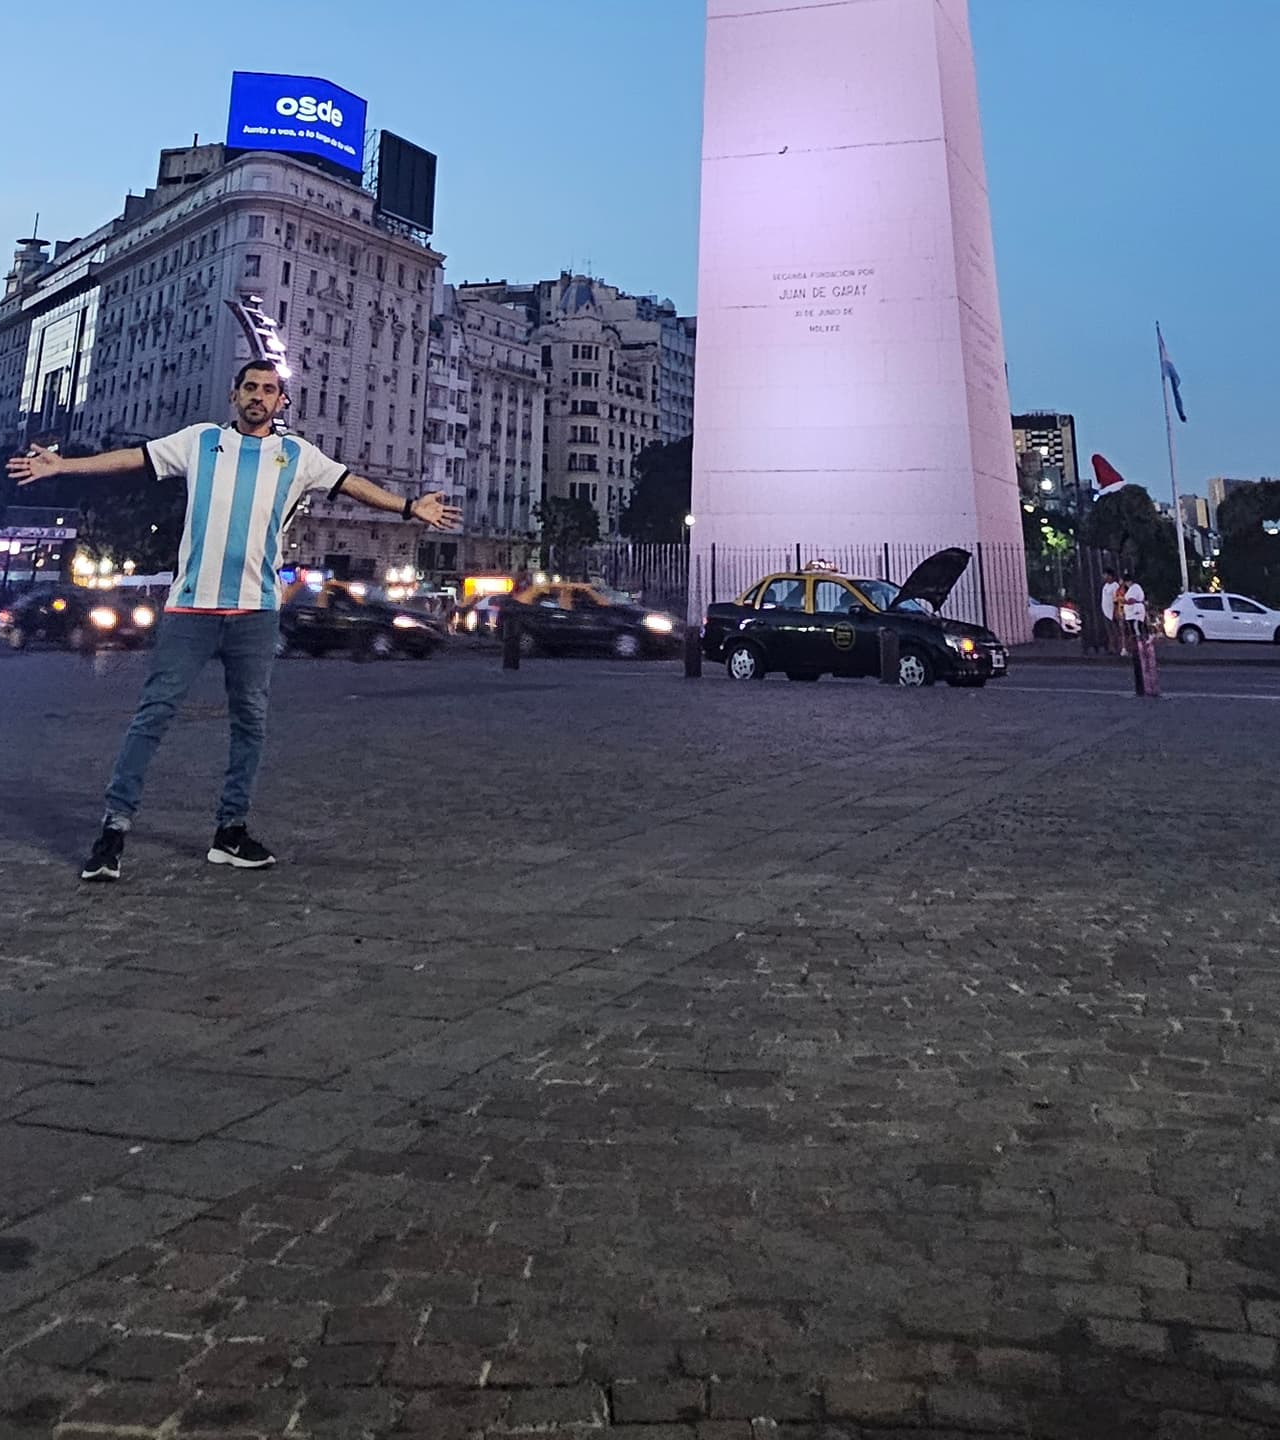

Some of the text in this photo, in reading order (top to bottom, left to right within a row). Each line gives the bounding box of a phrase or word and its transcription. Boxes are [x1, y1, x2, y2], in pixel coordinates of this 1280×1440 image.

[276, 96, 343, 127] osde
[779, 284, 867, 300] JUAN DE GARAY
